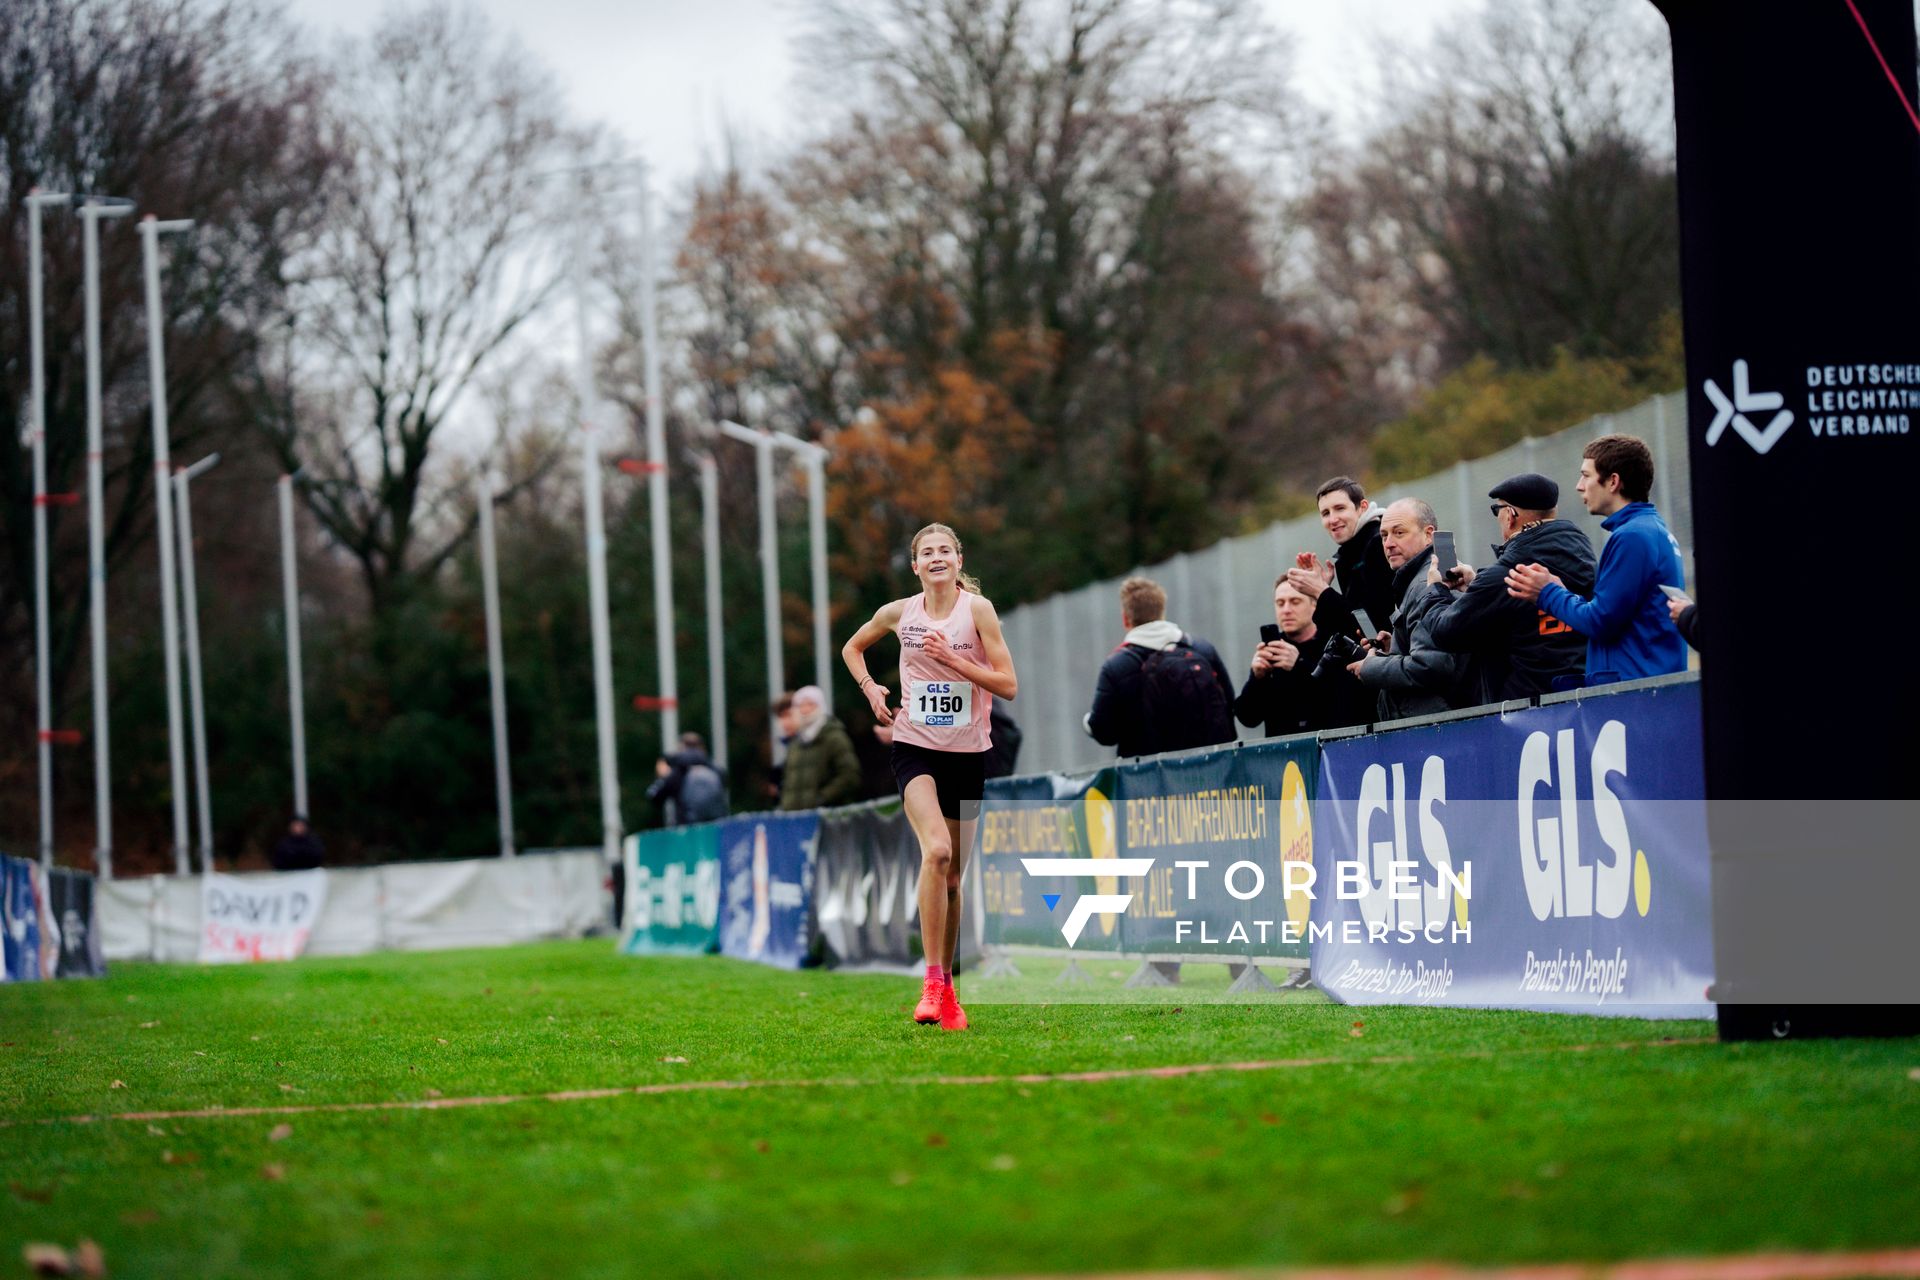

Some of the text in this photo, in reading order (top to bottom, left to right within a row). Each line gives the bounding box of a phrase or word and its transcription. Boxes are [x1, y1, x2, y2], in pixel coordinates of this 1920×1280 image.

[1808, 389, 1920, 412] LEICHTATH
[1809, 413, 1910, 437] VERBAND
[918, 695, 963, 713] 1150
[207, 888, 309, 925] DAVID
[1332, 958, 1453, 1004] Parcels to People
[1518, 946, 1628, 1006] Parcels to People
